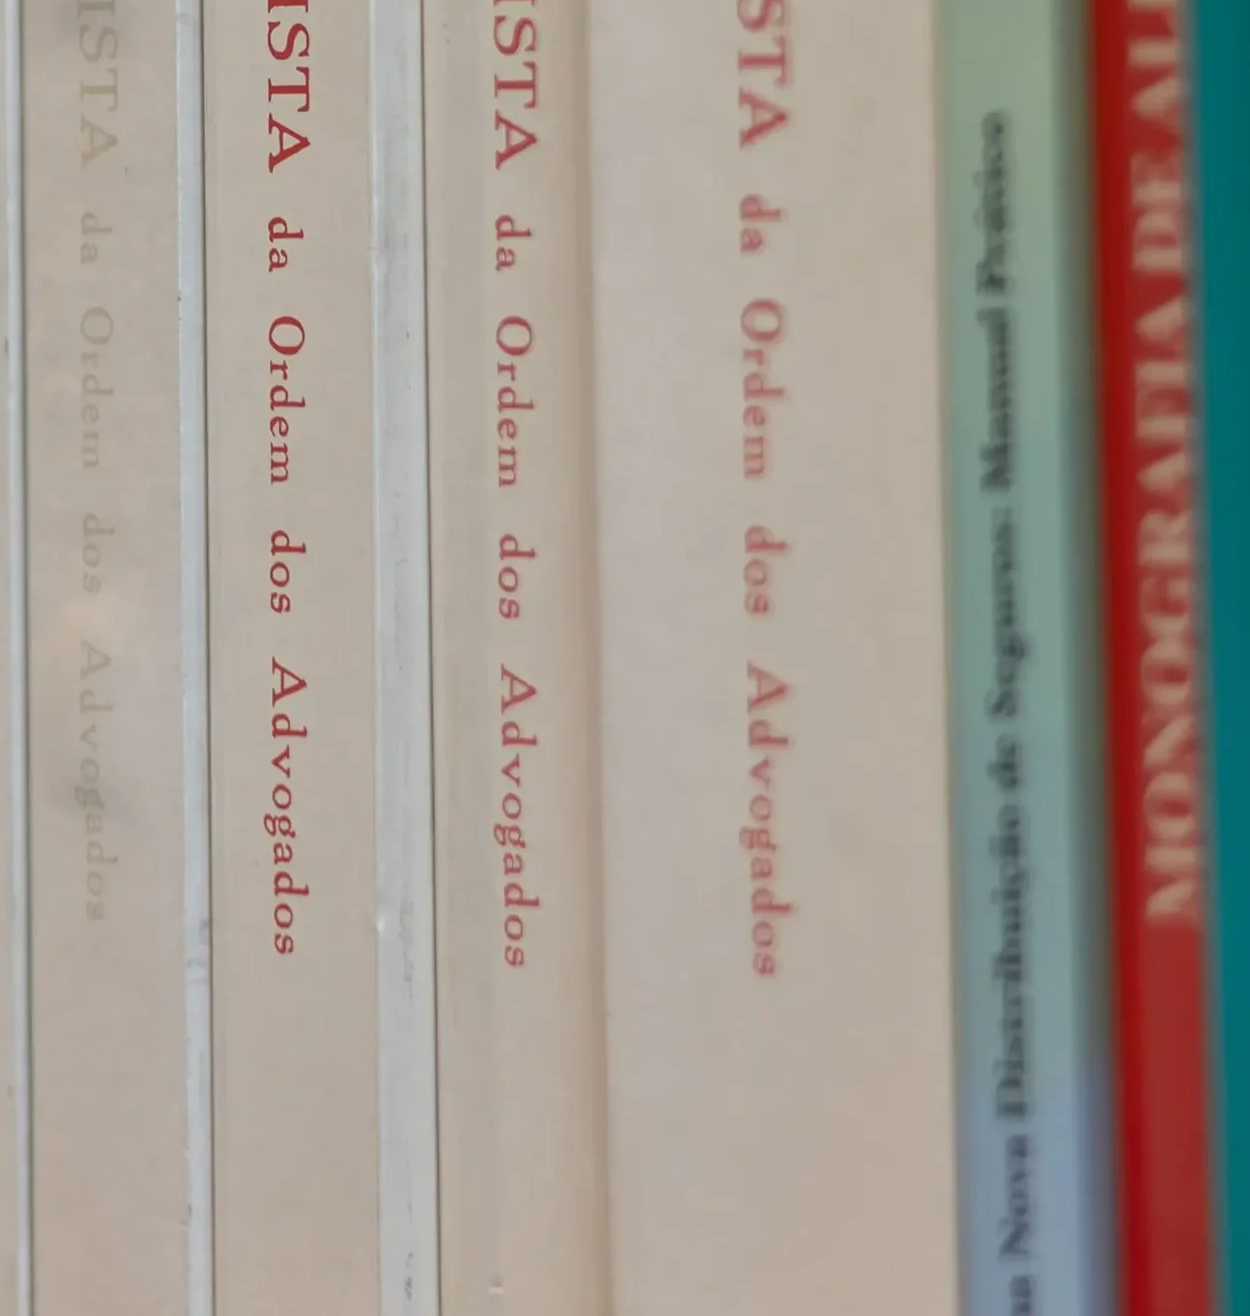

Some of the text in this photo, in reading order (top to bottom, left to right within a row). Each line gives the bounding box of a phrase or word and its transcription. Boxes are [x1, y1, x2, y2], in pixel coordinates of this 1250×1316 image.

[79, 211, 113, 266] da
[267, 216, 304, 273] da
[495, 214, 531, 272] da
[740, 194, 781, 257] da
[1130, 148, 1188, 276] DE
[78, 305, 113, 471] Ordem
[267, 315, 305, 487] Ordem
[496, 315, 534, 489] Ordem
[742, 298, 787, 482] Ordem
[978, 306, 1014, 496] Manual
[80, 512, 114, 595] dos
[269, 529, 305, 615] dos
[498, 533, 536, 621] dos
[743, 524, 789, 618] dos
[1134, 294, 1202, 920] MONOGRAFIA
[74, 637, 119, 924] Advogados
[263, 658, 309, 956] Advogados
[493, 663, 539, 970] Advogados
[739, 659, 795, 980] Advogados
[986, 733, 1022, 792] de
